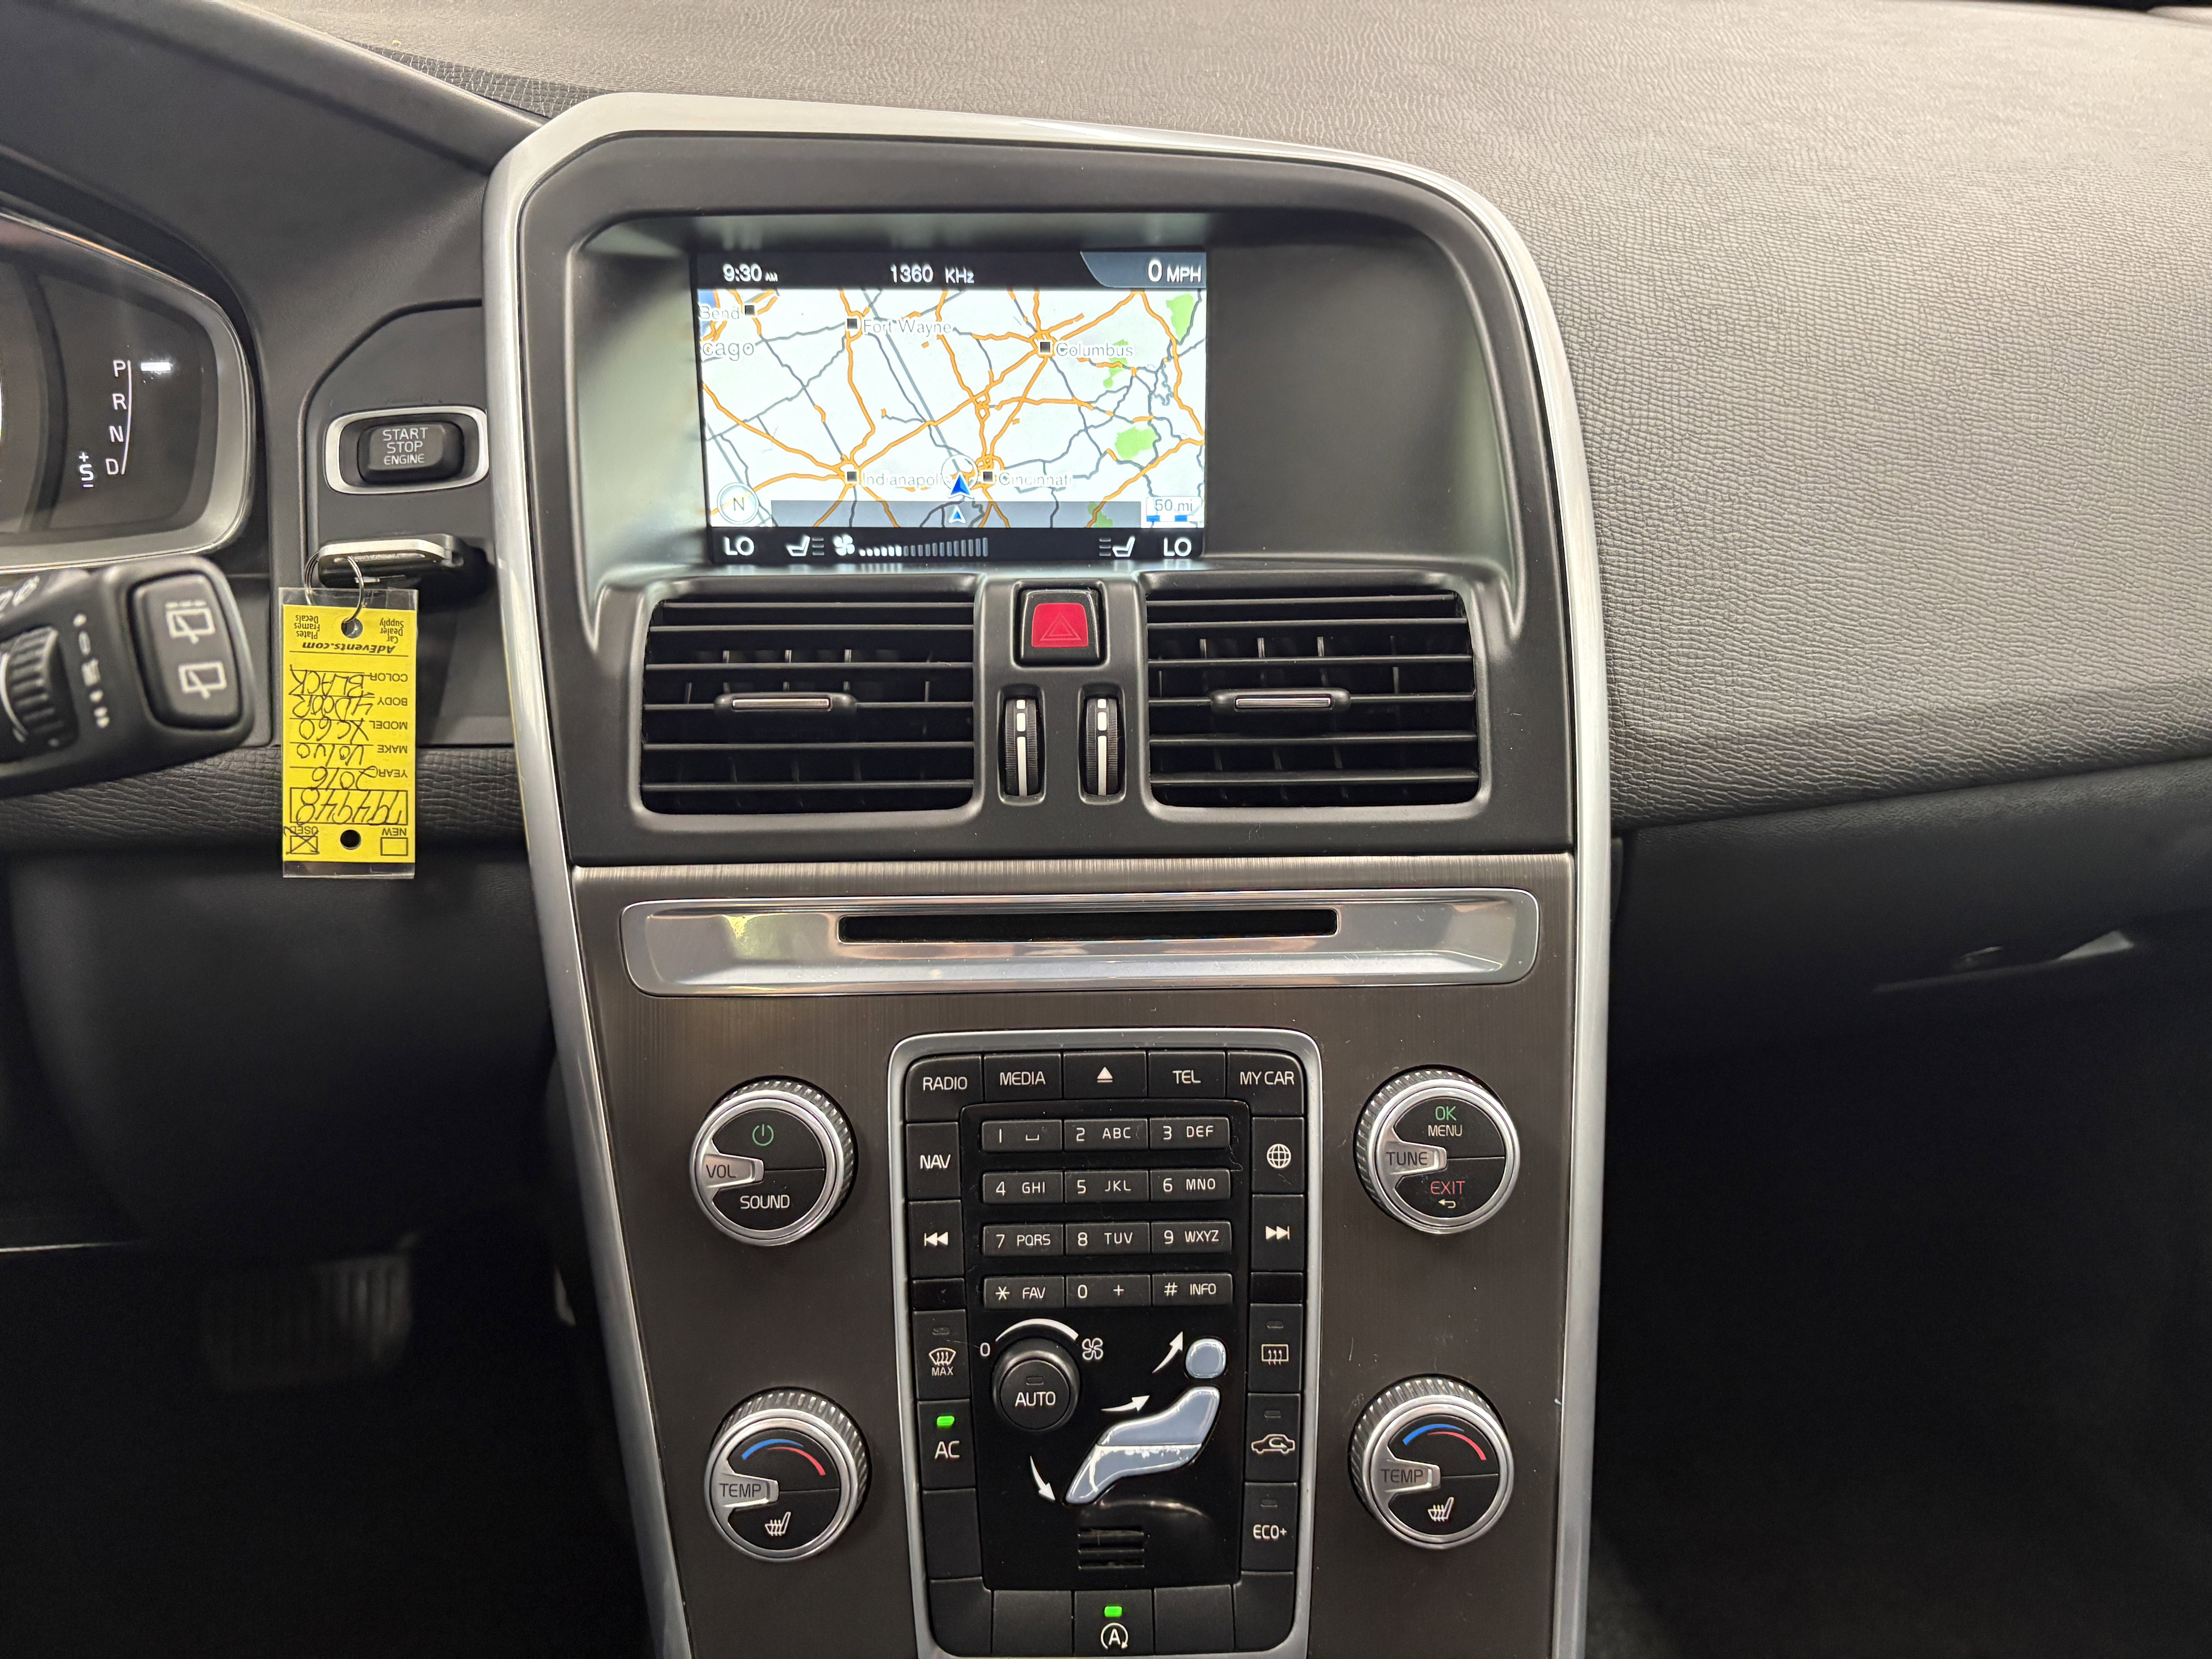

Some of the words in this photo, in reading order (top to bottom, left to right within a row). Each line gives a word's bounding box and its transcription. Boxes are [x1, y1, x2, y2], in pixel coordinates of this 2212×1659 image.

[723, 264, 762, 282] 9:30
[766, 272, 778, 282] AM
[891, 264, 933, 282] 1360
[945, 268, 974, 283] KHz
[1148, 259, 1162, 282] 0
[1167, 267, 1201, 282] MPH
[700, 306, 740, 319] Bend
[863, 320, 893, 333] Fort
[898, 320, 952, 339] Wayne
[702, 341, 754, 361] cago
[1056, 342, 1133, 357] Columbus
[113, 360, 126, 377] P
[112, 393, 127, 410] R
[110, 426, 124, 442] N
[383, 428, 428, 441] START
[387, 441, 423, 453] STOP
[106, 459, 118, 474] D
[384, 454, 425, 465] ENGINE
[999, 472, 1072, 486] Cincinnati
[733, 497, 744, 511] N
[1154, 500, 1173, 512] 50
[1177, 500, 1193, 512] mi
[725, 538, 754, 556] LO
[1164, 538, 1192, 557] LO
[295, 615, 318, 623] Decals
[380, 618, 404, 628] Supply
[294, 623, 320, 631] Frames
[380, 628, 403, 636] Dealer
[297, 631, 318, 639] Plates
[302, 642, 396, 653] AdEvents.com
[289, 665, 365, 696] BLACK
[370, 673, 408, 682] COLOR
[378, 697, 407, 706] BODY
[299, 717, 369, 744] XC60
[372, 721, 407, 730] MODEL
[312, 766, 378, 790] 2016
[379, 769, 407, 778] YEAR
[296, 788, 402, 826] 794948
[290, 826, 318, 834] USED
[923, 1077, 967, 1091] RADIO
[1000, 1071, 1045, 1085] MEDIA
[1173, 1070, 1200, 1084] TEL
[1240, 1071, 1262, 1085] MY
[1264, 1071, 1294, 1085] CAR
[1435, 1106, 1456, 1121] OK
[999, 1129, 1002, 1143] 1
[1076, 1128, 1085, 1141] 2
[1103, 1127, 1131, 1139] ABC
[1163, 1126, 1172, 1140] 3
[1187, 1125, 1213, 1137] DEF
[1428, 1125, 1462, 1136] MENU
[920, 1154, 951, 1169] NAV
[1386, 1152, 1427, 1165] TUNE
[706, 1164, 736, 1178] VOL
[996, 1181, 1006, 1195] 4
[1022, 1182, 1045, 1193] GHI
[1077, 1180, 1086, 1194] 5
[1105, 1180, 1131, 1191] JKL
[1163, 1178, 1173, 1192] 6
[1186, 1178, 1216, 1190] MNO
[1431, 1181, 1465, 1194] EXIT
[740, 1195, 790, 1209] SOUND
[996, 1234, 1005, 1248] 7
[1017, 1234, 1051, 1246] PQRS
[1078, 1232, 1088, 1246] 8
[1104, 1232, 1132, 1244] TUV
[1164, 1230, 1173, 1244] 9
[1185, 1230, 1219, 1242] WXYZ
[1023, 1288, 1045, 1299] FAV
[1078, 1285, 1087, 1298] 0
[1190, 1283, 1216, 1295] INFO
[980, 1343, 990, 1356] 0
[932, 1367, 953, 1376] MAX
[1015, 1391, 1056, 1407] AUTO
[935, 1441, 960, 1459] AC
[1381, 1468, 1423, 1483] TEMP
[719, 1483, 761, 1498] TEMP
[1253, 1524, 1287, 1539] ECO+
